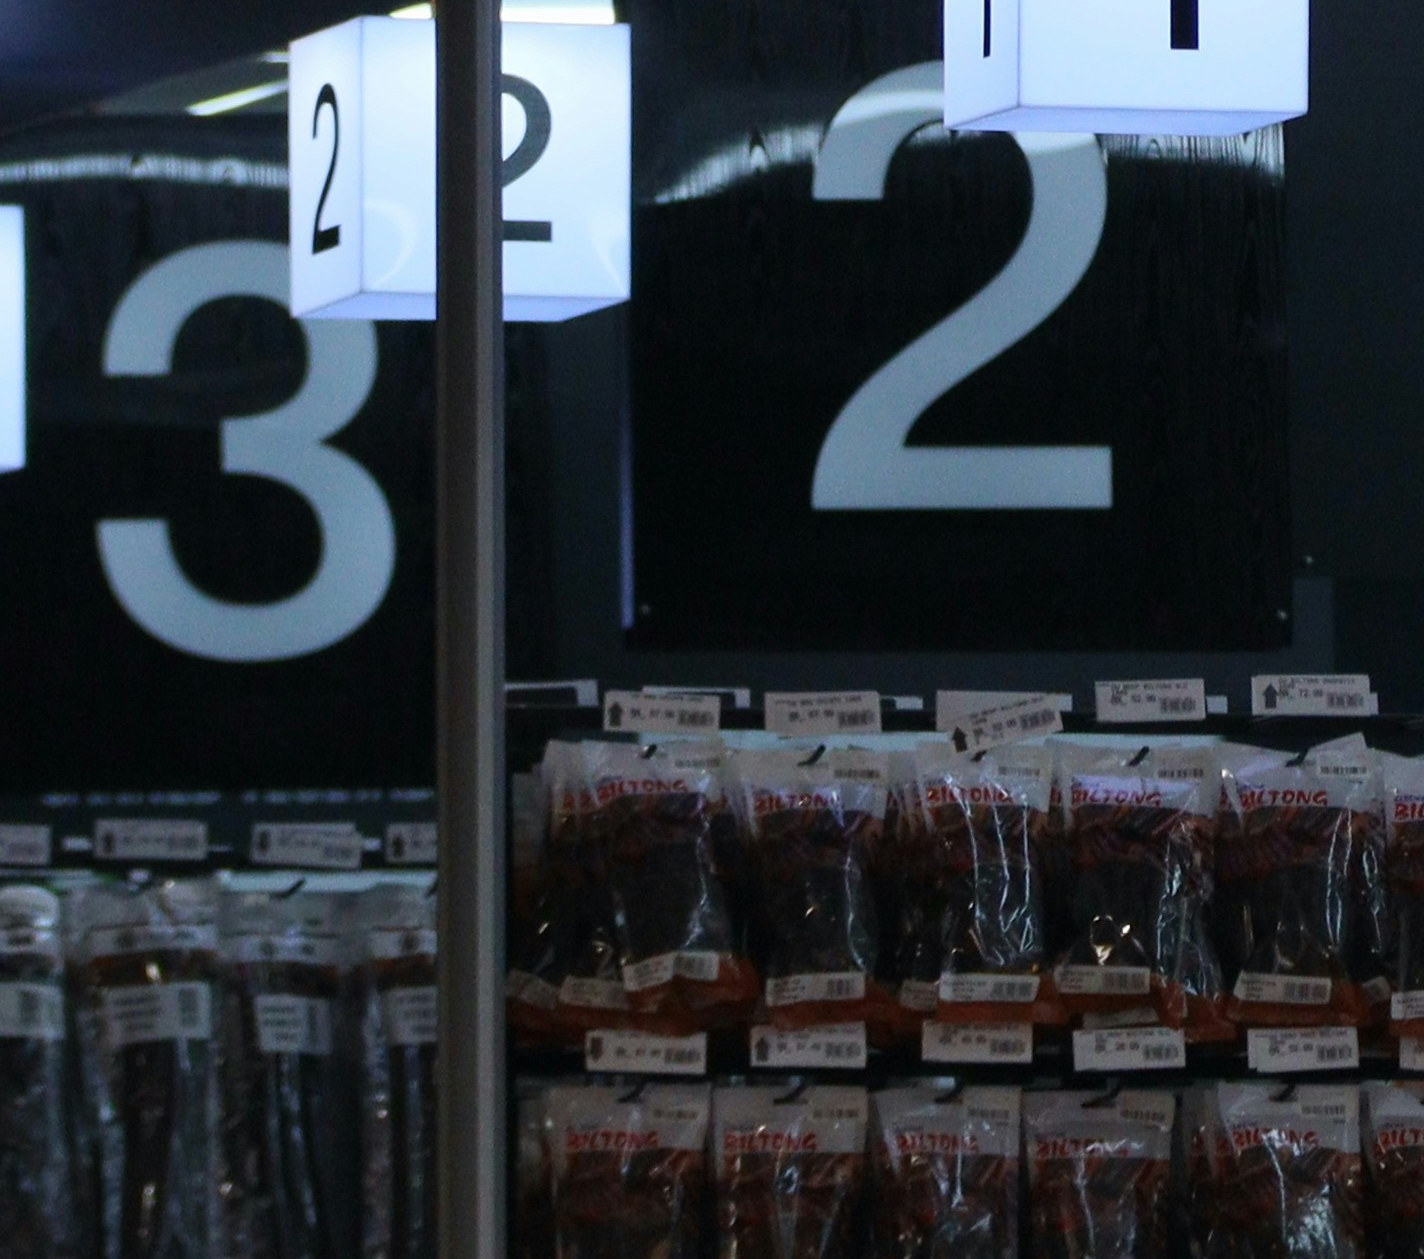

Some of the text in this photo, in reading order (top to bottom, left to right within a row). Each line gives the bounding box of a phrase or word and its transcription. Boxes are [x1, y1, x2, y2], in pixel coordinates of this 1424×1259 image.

[312, 82, 341, 255] 2
[811, 59, 1114, 510] 2
[94, 238, 397, 663] 3
